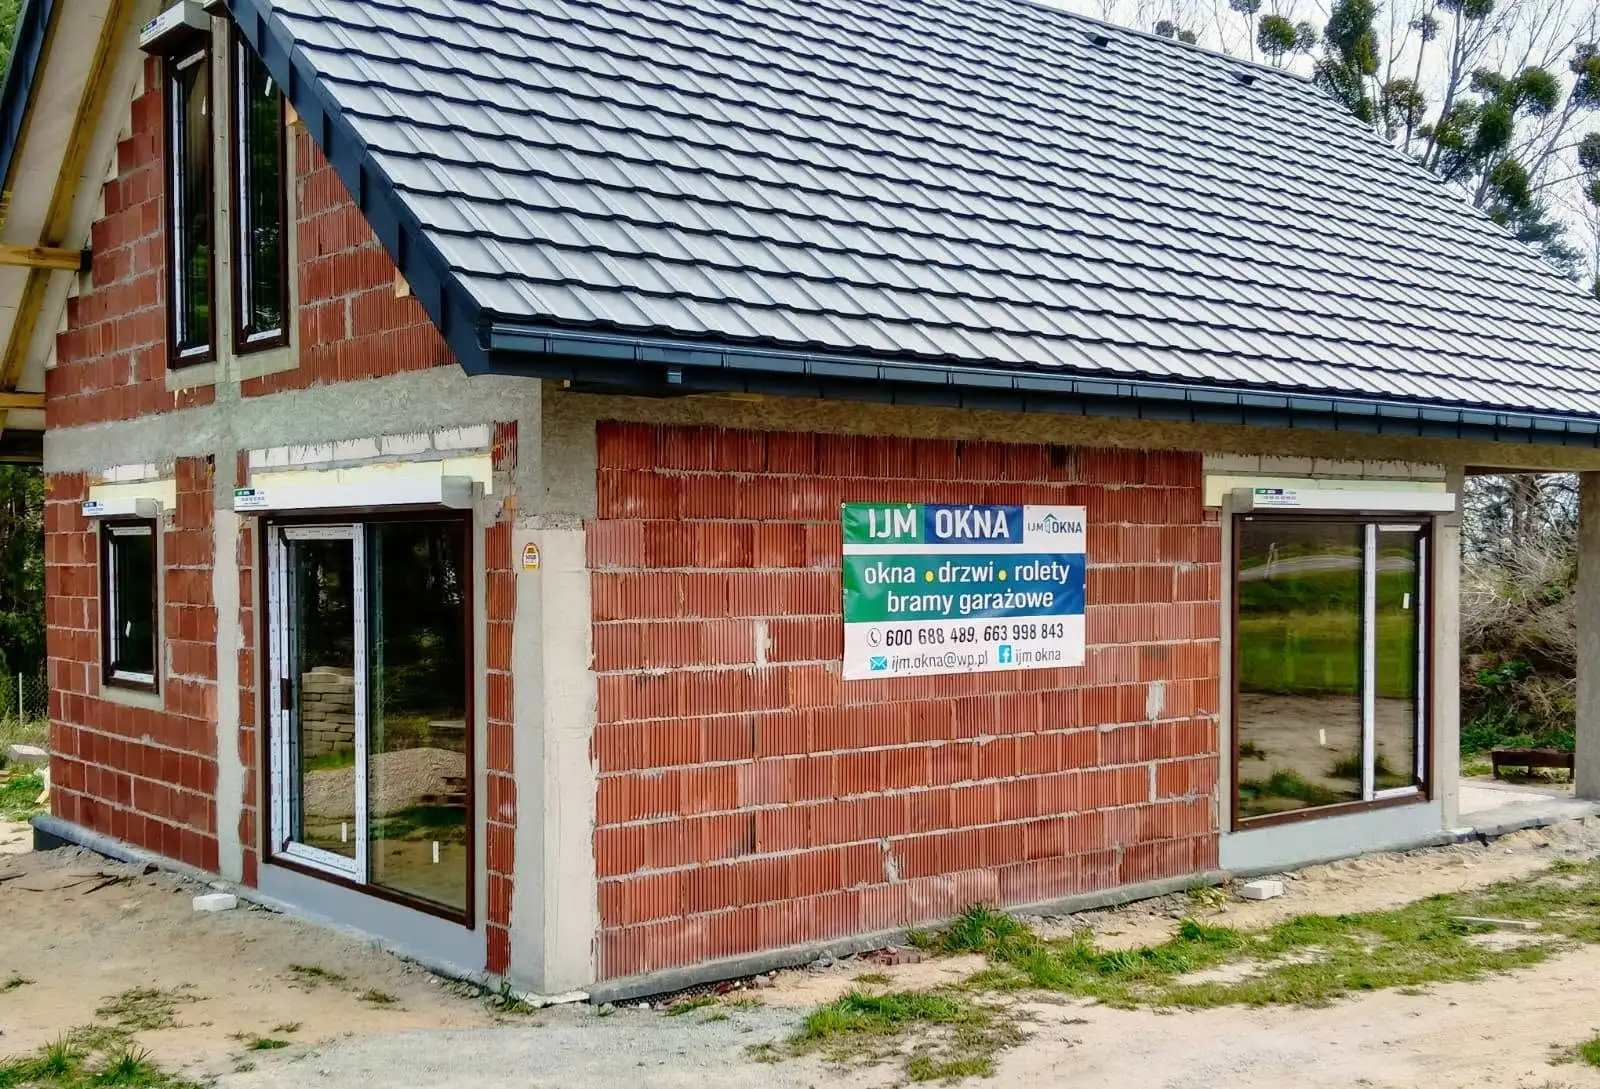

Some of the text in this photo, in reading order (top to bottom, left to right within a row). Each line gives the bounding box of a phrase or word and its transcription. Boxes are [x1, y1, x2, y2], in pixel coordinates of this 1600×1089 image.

[868, 508, 1010, 539] IJM OKNA
[1027, 521, 1083, 534] IJM OKNA
[864, 560, 1071, 585] okna drzwi rolety
[887, 588, 1054, 615] bramy garażowe
[886, 622, 1064, 647] 600 688 489, 663 998 843
[891, 649, 988, 674] ijm.okna@wp.pl
[1015, 648, 1032, 665] ijm
[1035, 647, 1061, 662] okna
